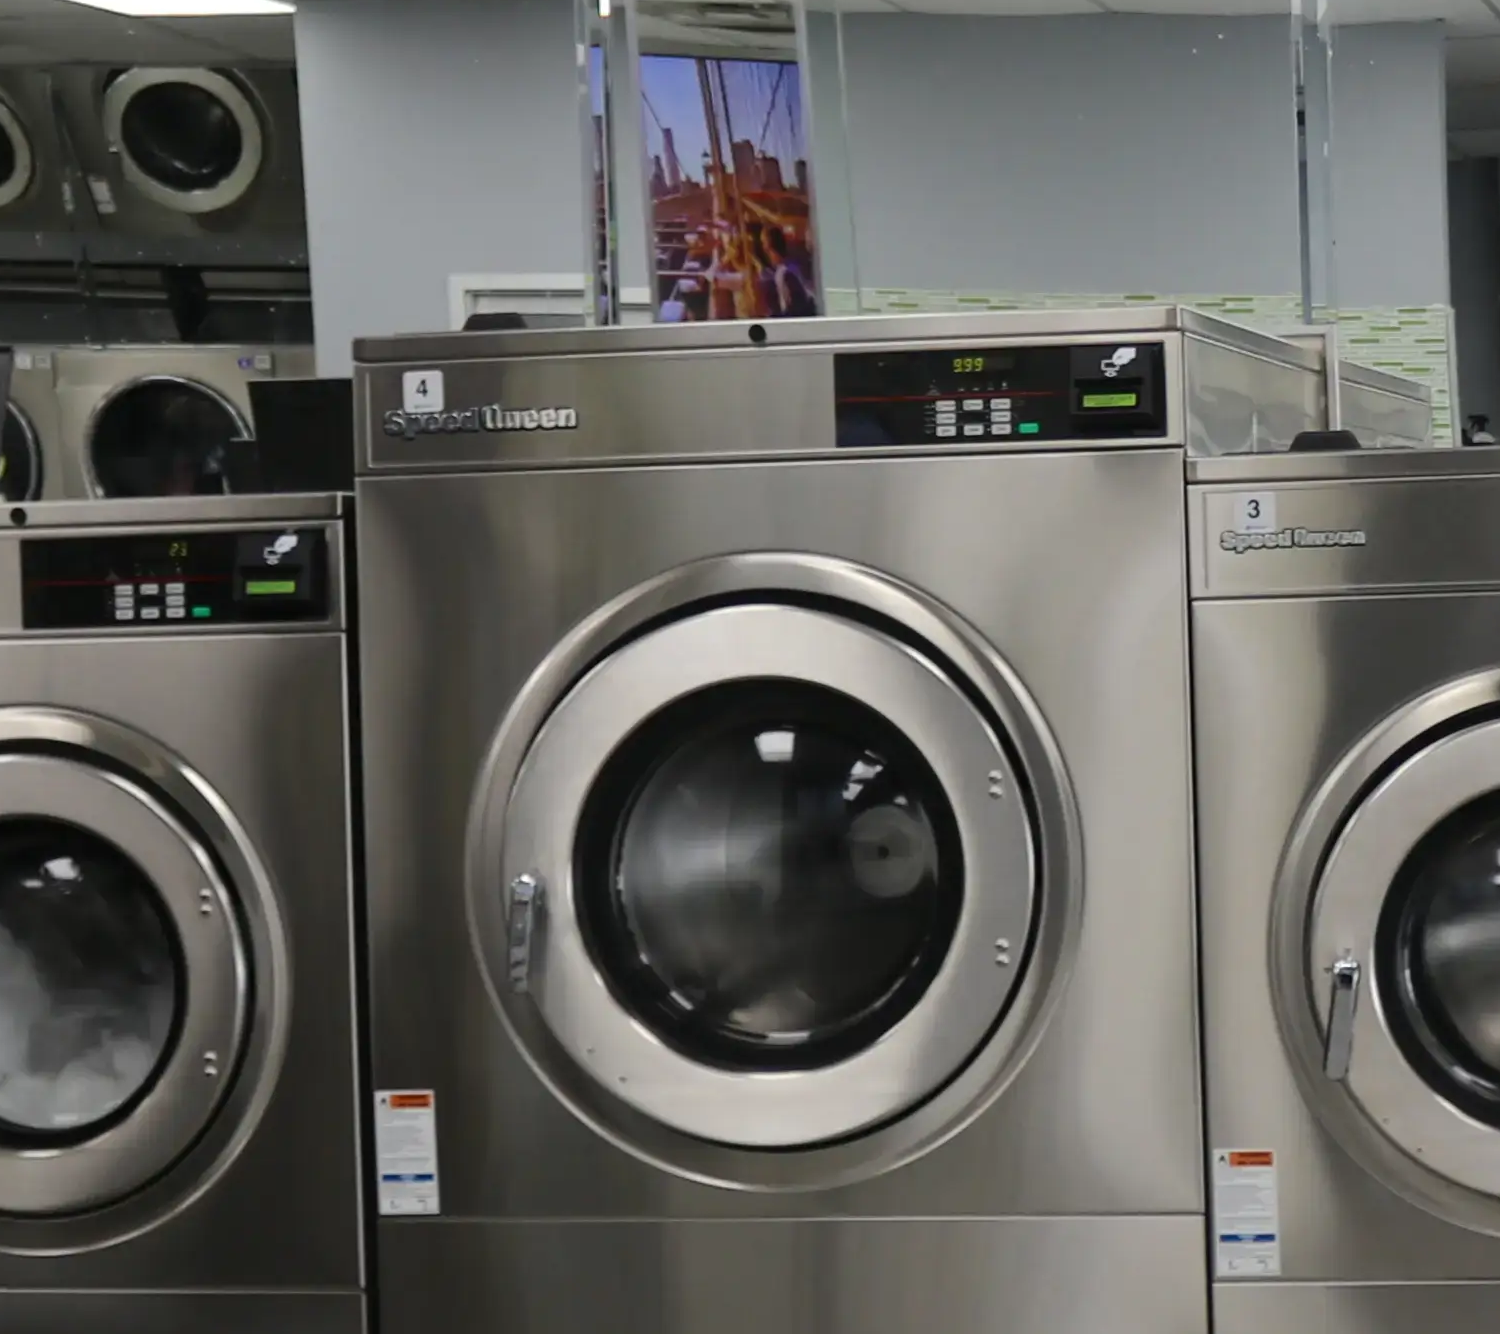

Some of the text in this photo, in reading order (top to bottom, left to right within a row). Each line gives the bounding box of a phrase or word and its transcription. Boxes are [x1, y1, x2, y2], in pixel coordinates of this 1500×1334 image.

[416, 380, 428, 397] 4
[384, 404, 578, 439] Speed Queen
[1247, 499, 1260, 518] 3
[1219, 527, 1366, 553] Speed Queen
